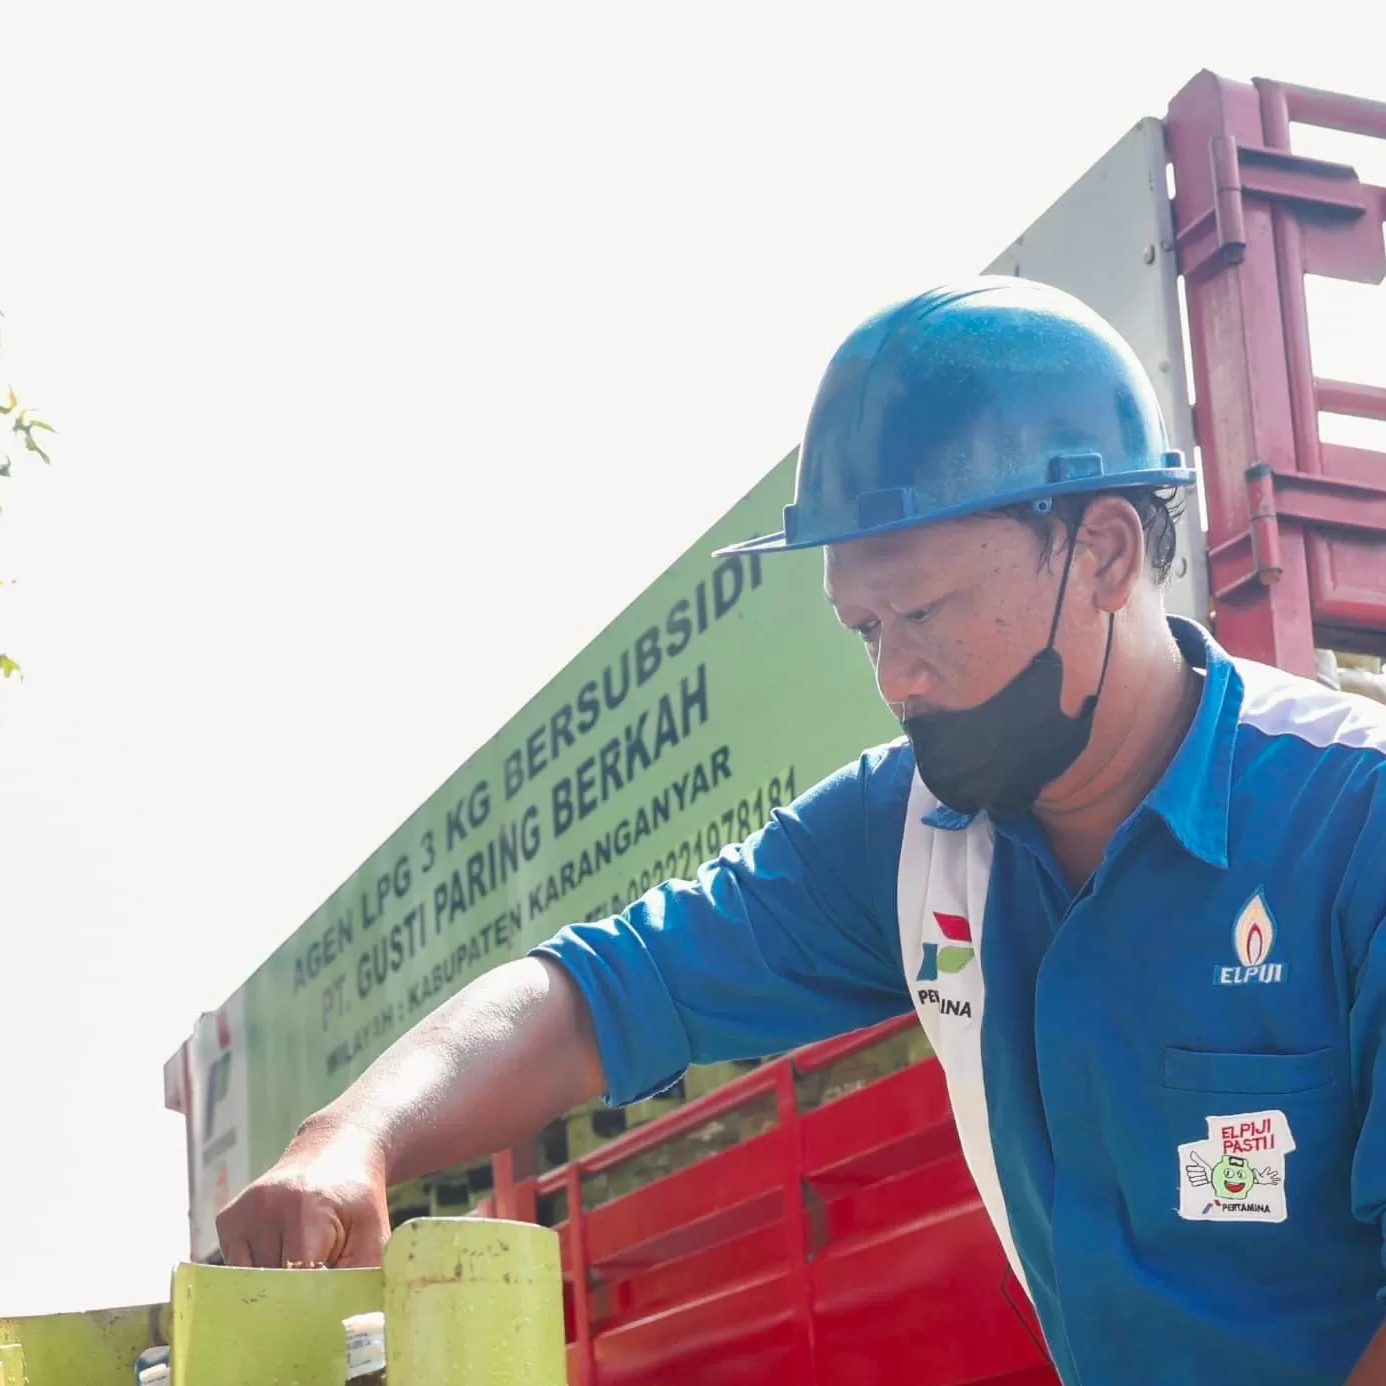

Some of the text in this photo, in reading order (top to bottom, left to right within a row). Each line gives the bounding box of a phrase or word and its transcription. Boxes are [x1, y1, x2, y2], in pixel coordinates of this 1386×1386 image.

[293, 534, 764, 994] AGEN LPG 3 KG BERSUBSIDI
[355, 901, 427, 999] GUSTI
[432, 804, 541, 935] PARING
[551, 662, 709, 840] BERKAH
[408, 902, 522, 1014] KABUPATEN
[527, 744, 734, 921] KARANGANYAR
[1220, 962, 1283, 985] ELPIJI
[1221, 1117, 1271, 1140] ELPIJI
[1221, 1202, 1271, 1214] PERTAMINA
